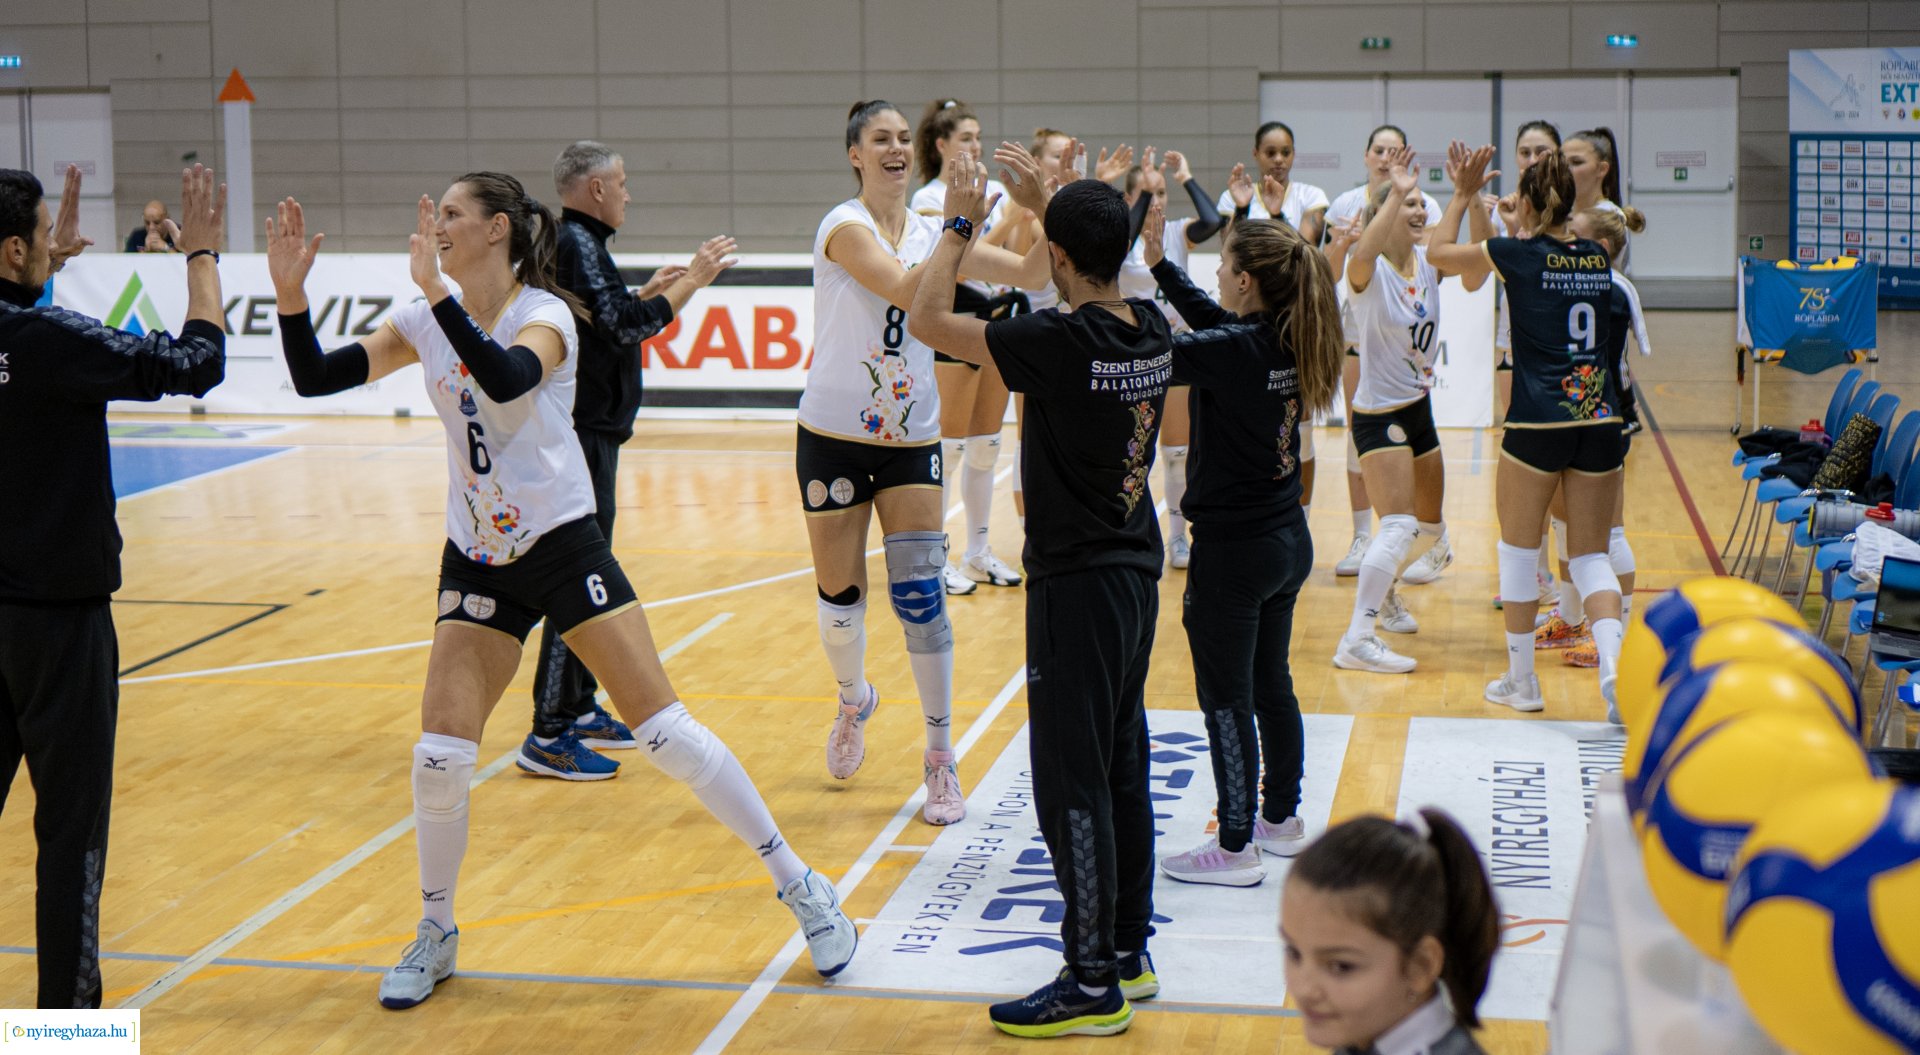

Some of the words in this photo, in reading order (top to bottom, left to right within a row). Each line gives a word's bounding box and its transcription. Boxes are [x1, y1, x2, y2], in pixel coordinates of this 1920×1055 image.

[1547, 253, 1606, 269] GATARD
[641, 305, 814, 370] RAB
[884, 304, 906, 348] 8
[1408, 321, 1435, 353] 10
[1568, 302, 1596, 352] 9
[1091, 360, 1131, 374] SZENT
[1120, 386, 1164, 401] röplabda
[467, 421, 492, 475] 6
[930, 454, 941, 480] 8
[586, 573, 609, 606] 6
[980, 822, 1012, 831] A
